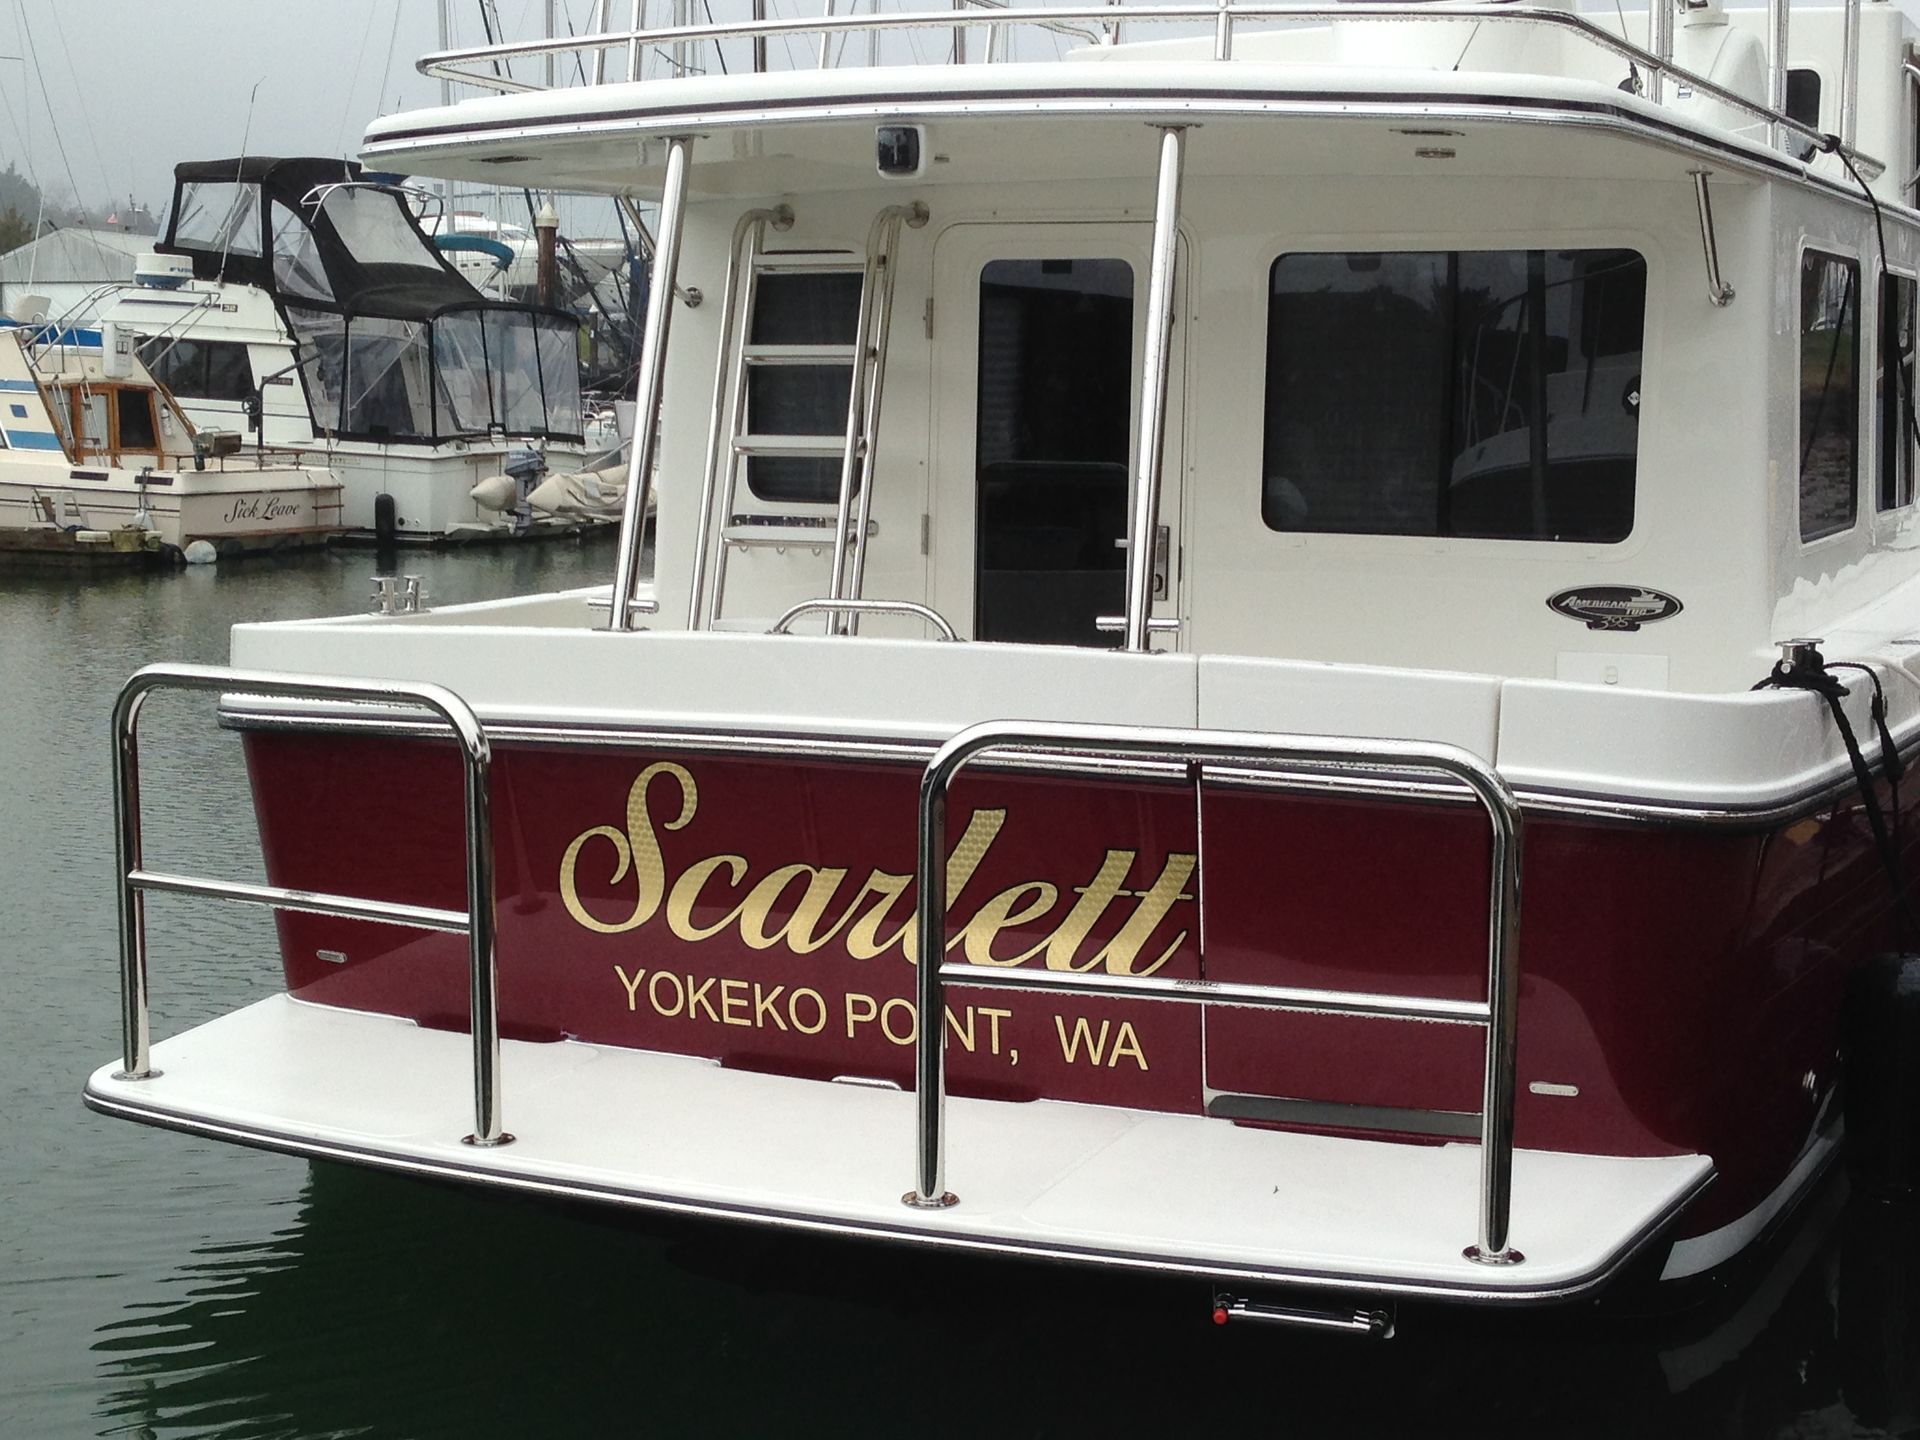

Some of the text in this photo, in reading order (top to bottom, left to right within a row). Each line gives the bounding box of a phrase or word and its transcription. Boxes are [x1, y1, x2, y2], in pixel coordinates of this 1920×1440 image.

[224, 497, 300, 523] Sick Leave
[559, 761, 1197, 977] Scarlett
[614, 964, 1149, 1071] YOKEKO PONT, WA
